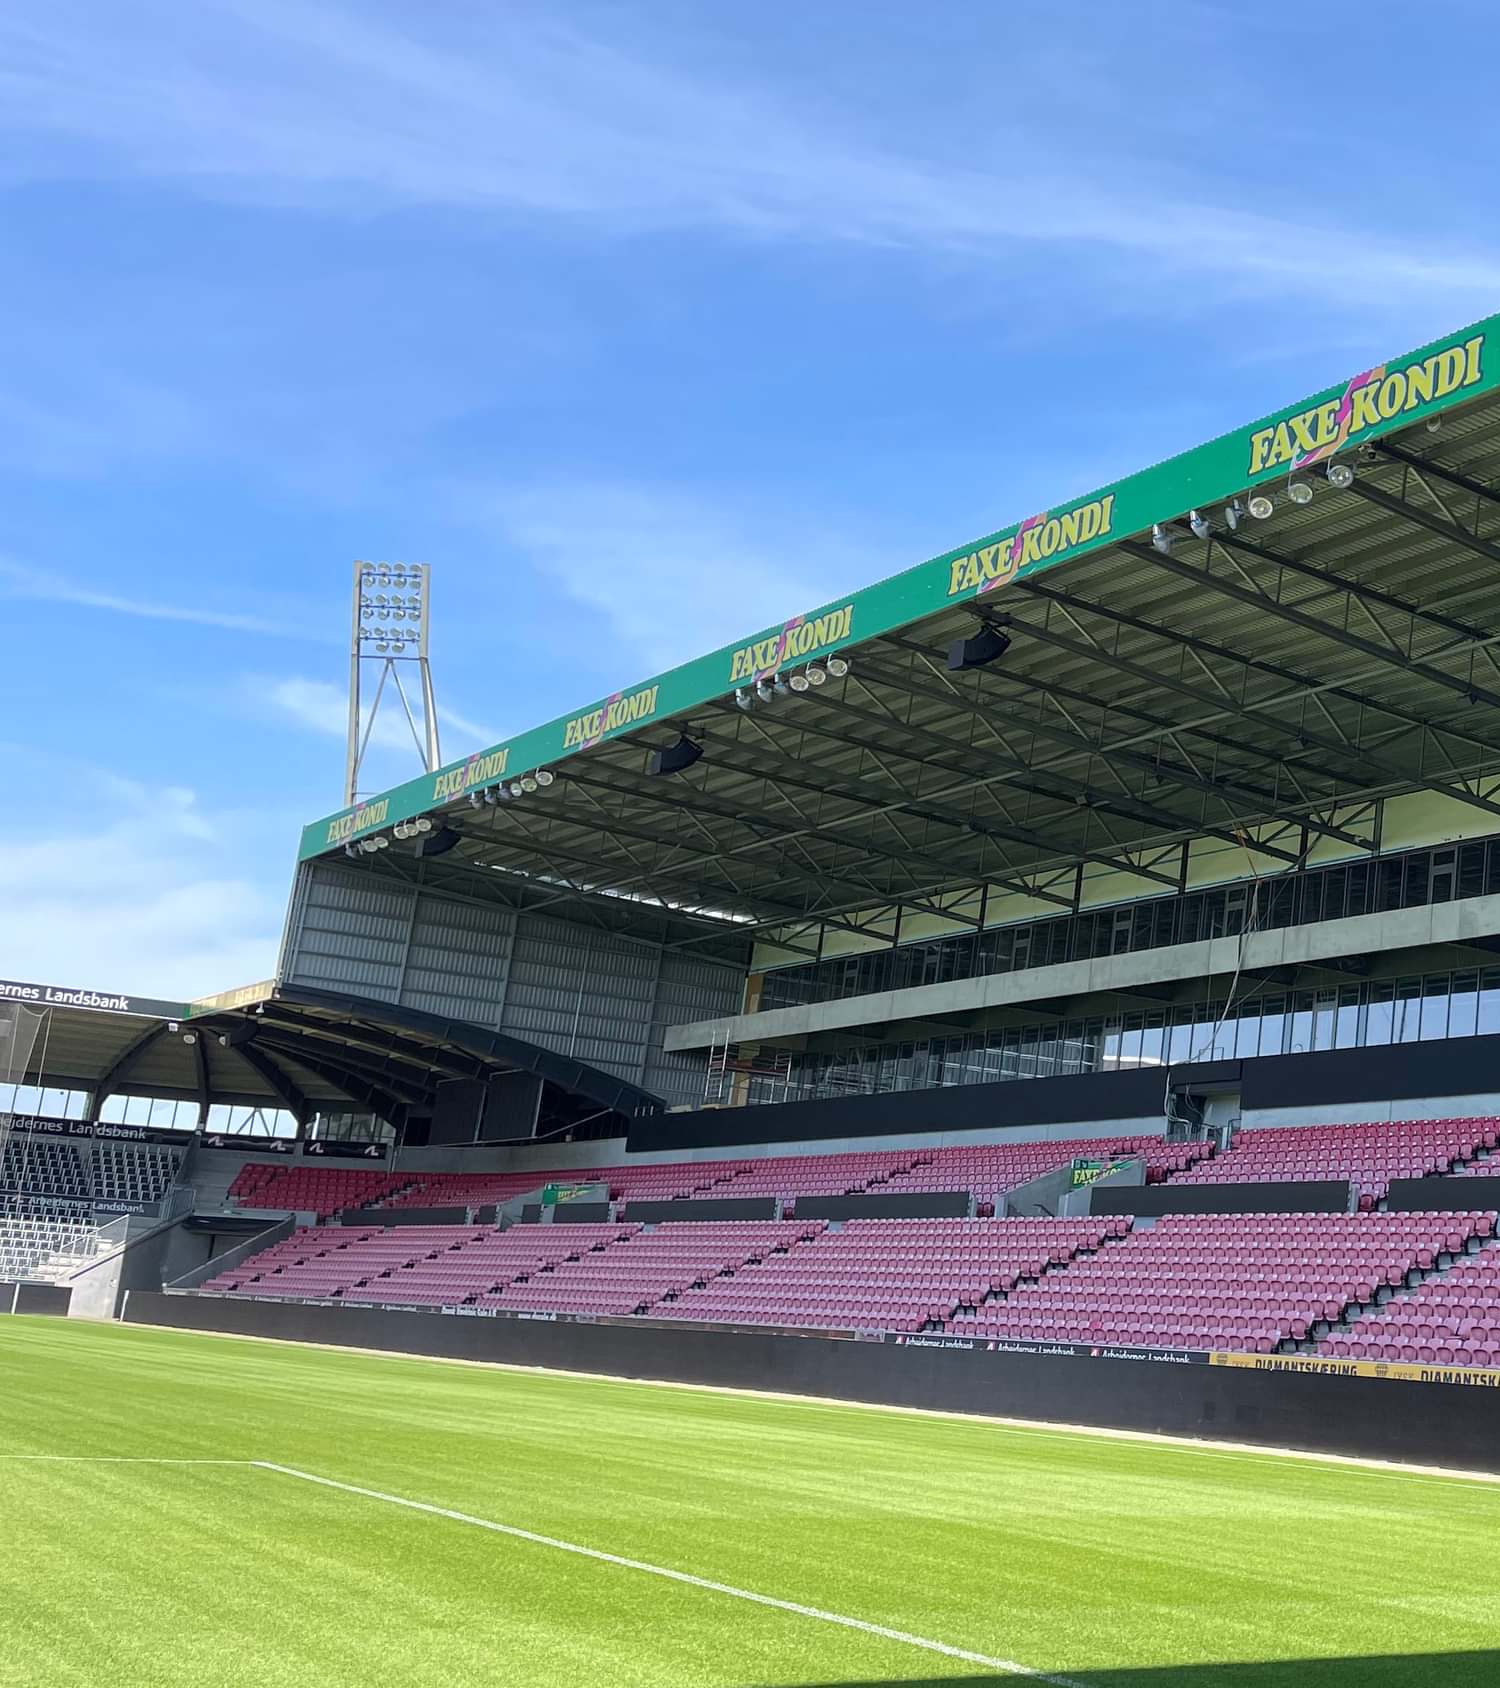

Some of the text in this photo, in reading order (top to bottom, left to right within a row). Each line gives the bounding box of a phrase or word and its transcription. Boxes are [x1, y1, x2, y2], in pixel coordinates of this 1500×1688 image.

[1248, 336, 1485, 475] FAXE KONDI
[947, 494, 1115, 596] FAXE KONDI
[729, 605, 854, 682] FAXE KONDI
[562, 684, 660, 749] FAXE KONDI
[432, 747, 510, 801] FAXE KONDI
[45, 987, 129, 1010] Landsbank
[69, 1121, 146, 1139] Landsbank
